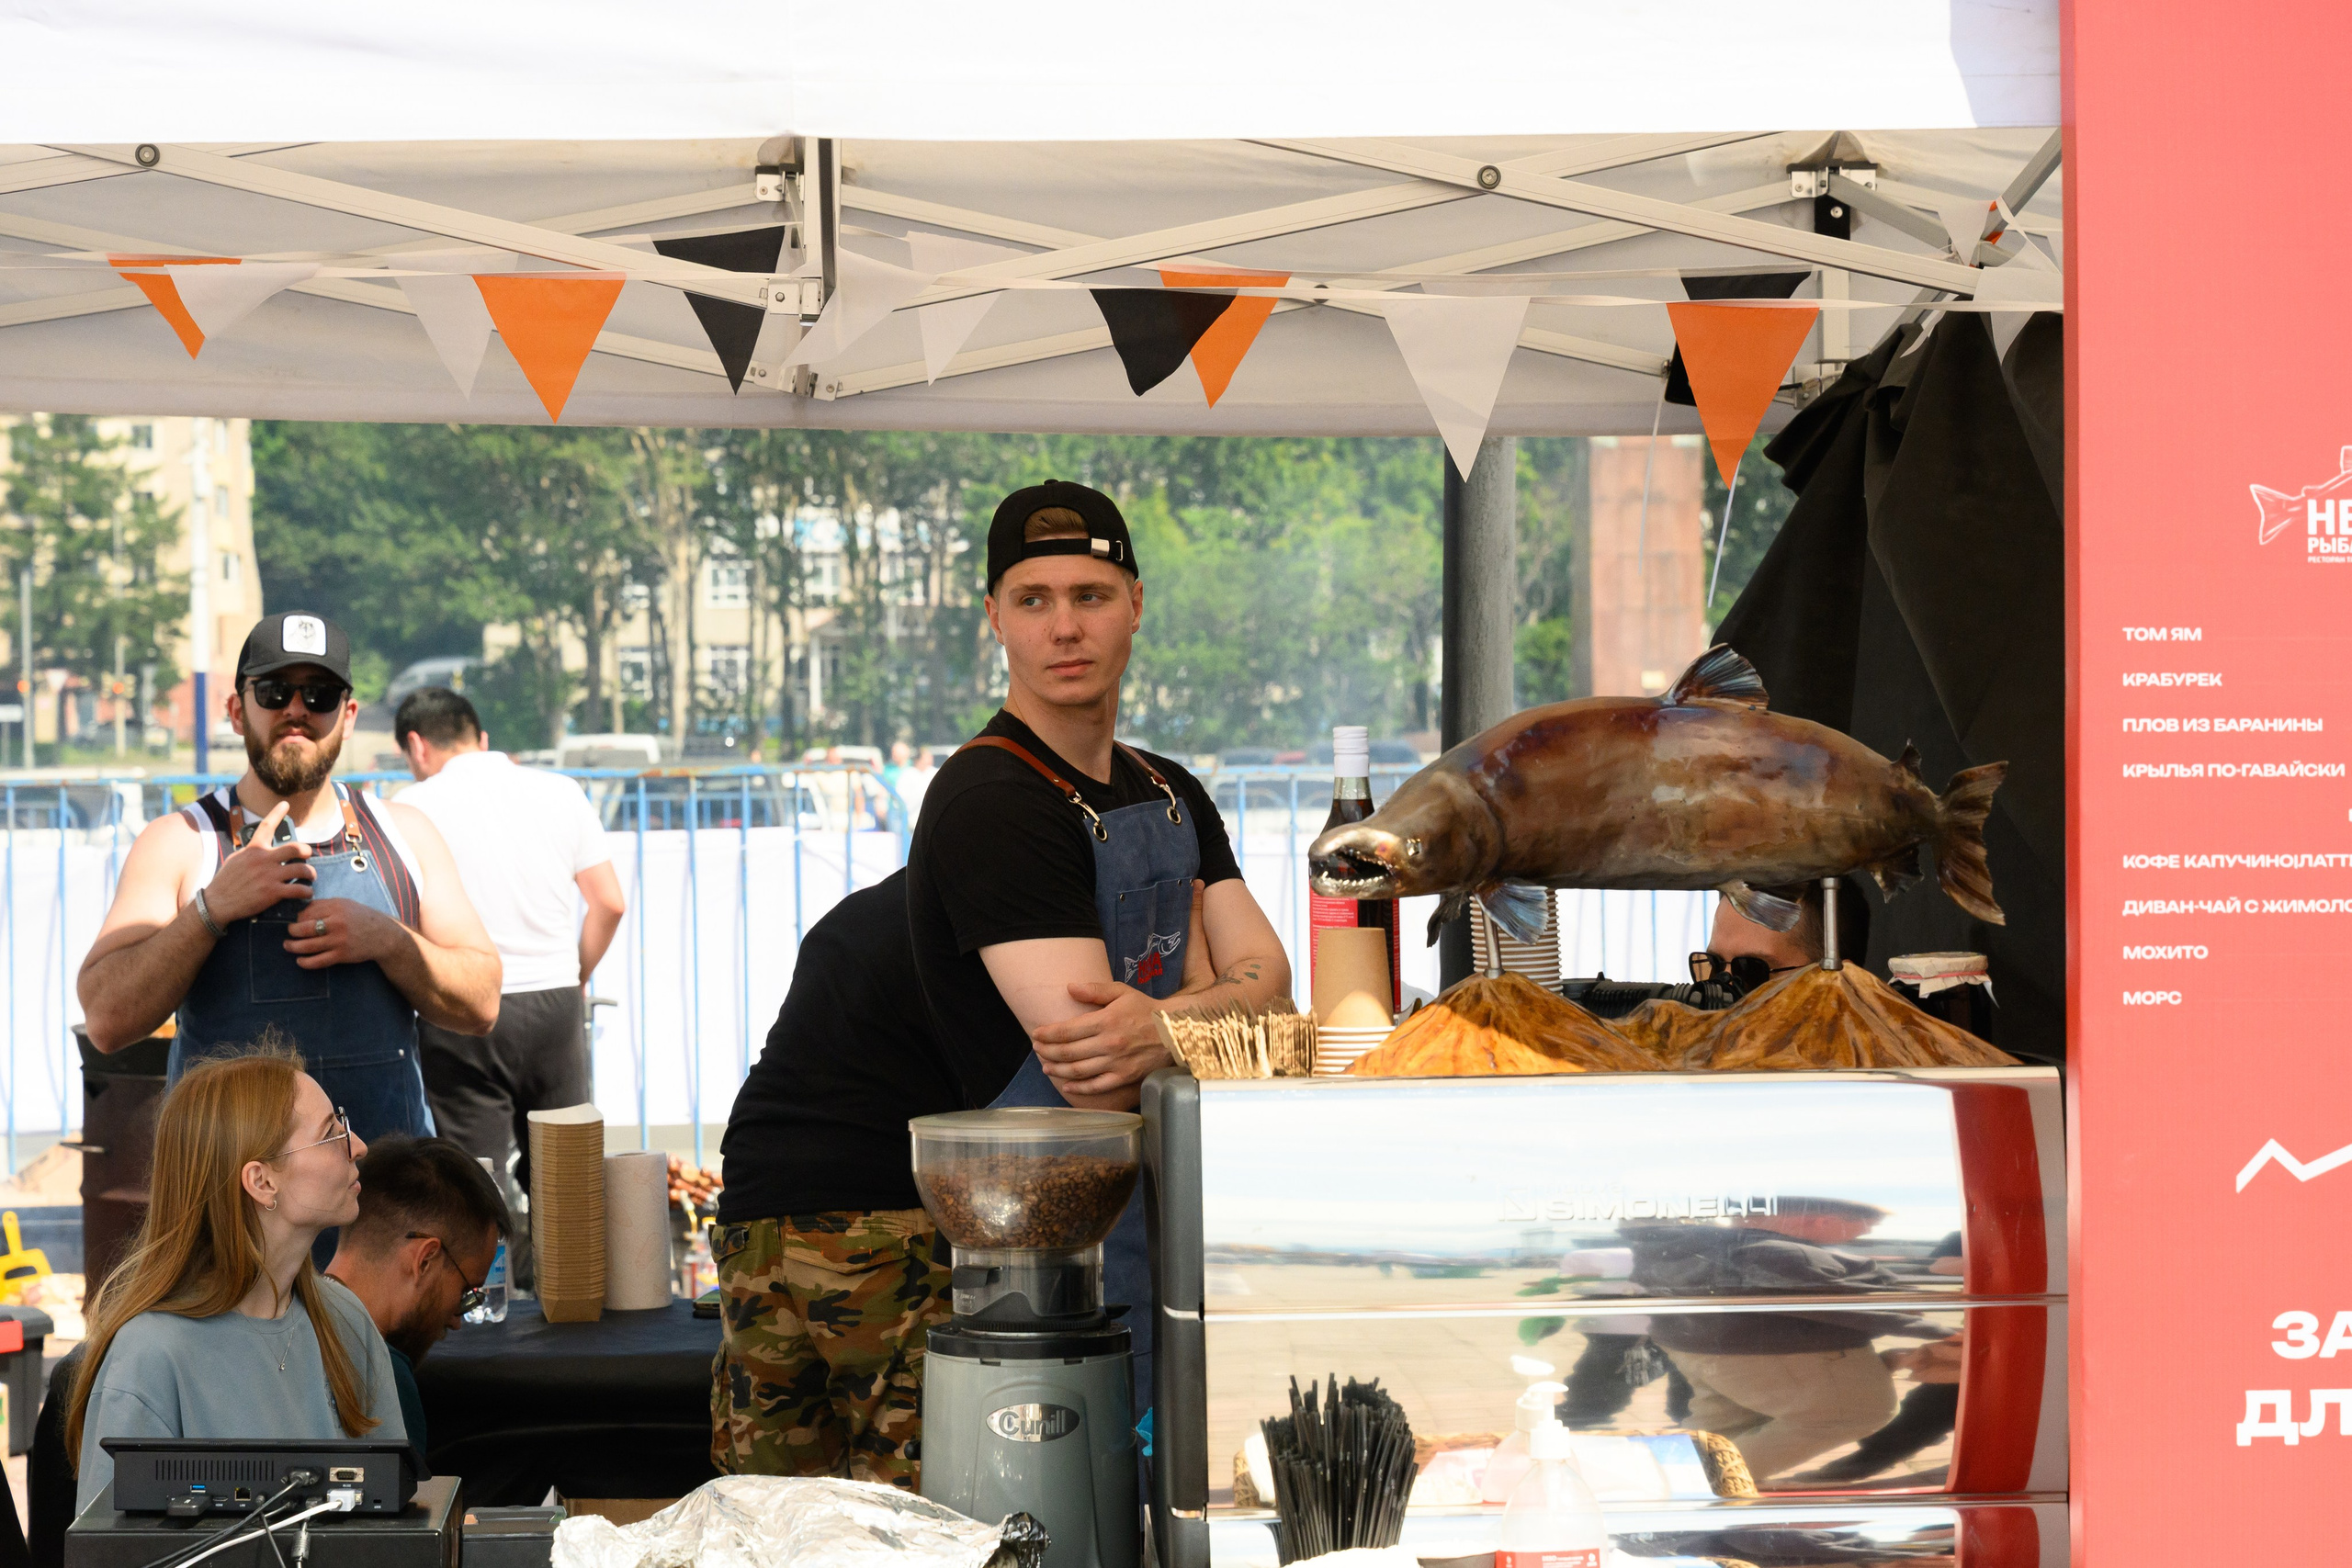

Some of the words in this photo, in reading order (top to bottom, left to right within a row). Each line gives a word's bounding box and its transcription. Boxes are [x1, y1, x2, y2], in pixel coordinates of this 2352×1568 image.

[2307, 536, 2352, 554] РЫБ
[2122, 626, 2167, 641] ТОМ
[2170, 626, 2202, 641] ЯМ
[2122, 672, 2222, 687] КРАБУРЕК
[2122, 717, 2179, 732] ПЛОВ
[2182, 717, 2211, 732] ИЗ
[2213, 717, 2324, 732] БАРАНИНЫ
[2122, 763, 2204, 778] КРЫЛЬЯ
[2207, 760, 2346, 778] ПО-ГАВАЙСКИ
[2122, 854, 2180, 868] КОФЕ
[2122, 897, 2241, 916] ДИВАН-ЧАЙ
[2245, 898, 2259, 914] С
[2122, 944, 2209, 959] МОХИТО
[2122, 990, 2183, 1005] МОРС
[1545, 1192, 1778, 1221] SIMONELLI
